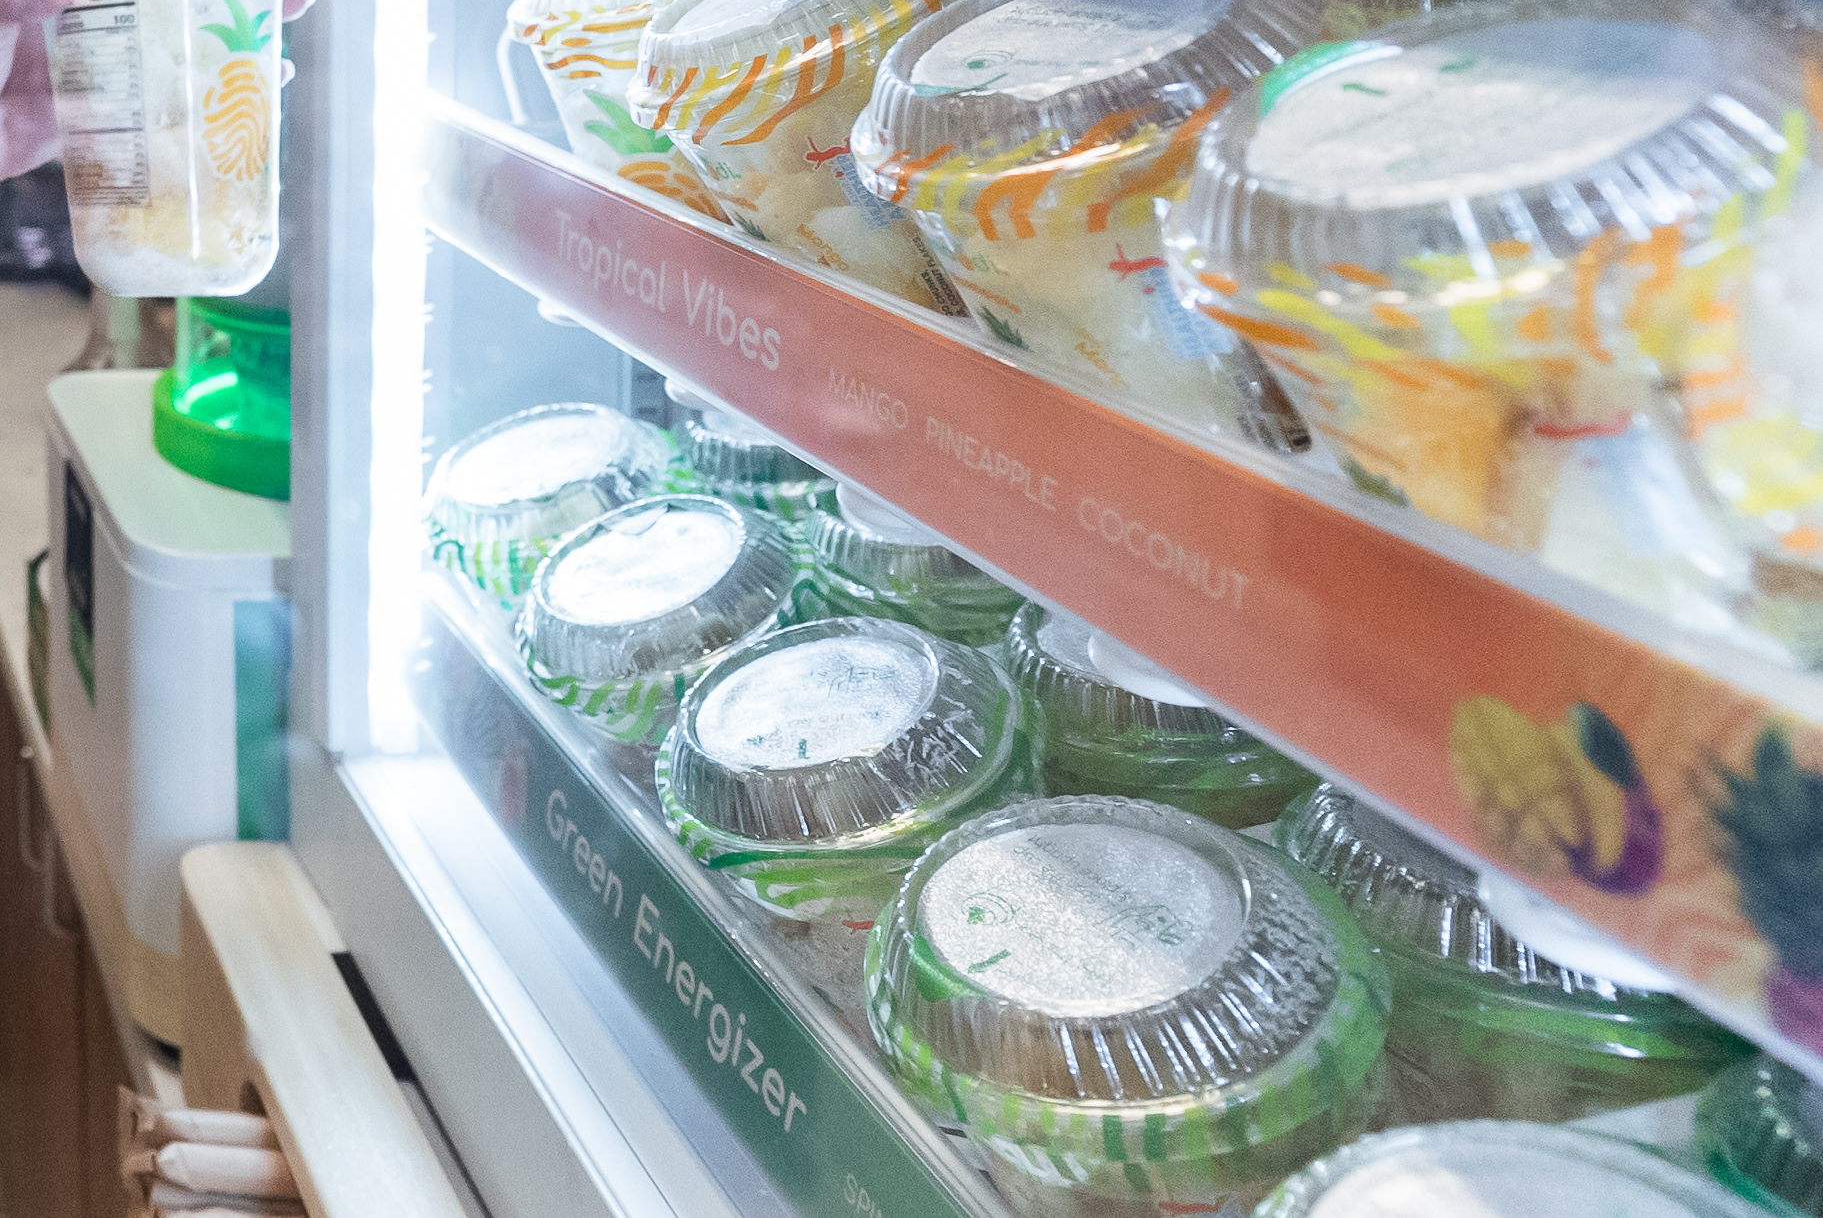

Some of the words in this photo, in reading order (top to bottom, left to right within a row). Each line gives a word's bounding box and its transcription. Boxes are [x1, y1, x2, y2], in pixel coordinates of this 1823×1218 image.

[554, 209, 670, 315] Tropical
[682, 270, 782, 374] Vibes
[828, 367, 909, 431] MANGO
[925, 416, 1057, 513] PINEAPPLE
[1078, 496, 1249, 609] COCONUT
[546, 788, 623, 918] Green
[633, 893, 808, 1133] Energizer
